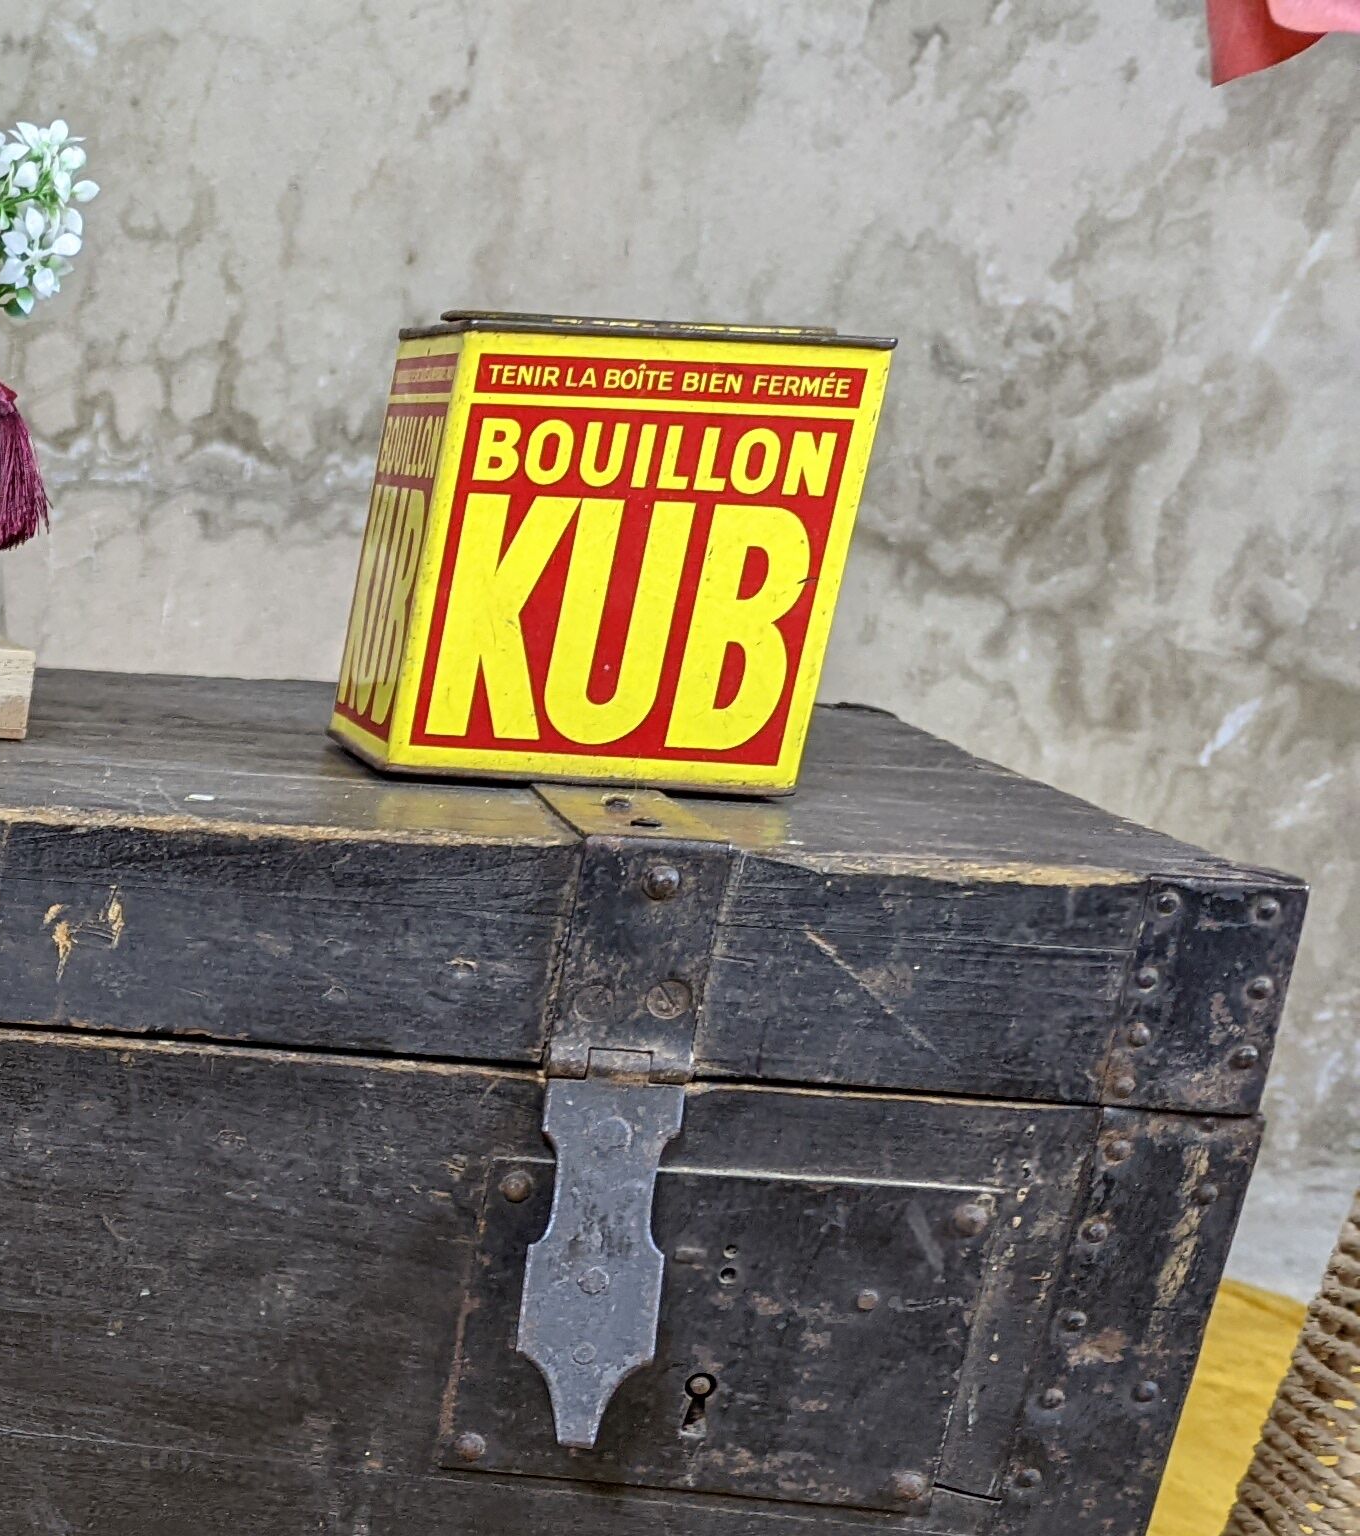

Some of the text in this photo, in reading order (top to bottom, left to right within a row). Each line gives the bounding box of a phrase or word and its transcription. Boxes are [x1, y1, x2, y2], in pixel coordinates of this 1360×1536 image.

[471, 417, 837, 497] BOUILLON
[489, 363, 851, 399] TENIR LA BOÎTE BIEN FERMÉE
[337, 484, 426, 725] KUB
[424, 493, 810, 750] KUB
